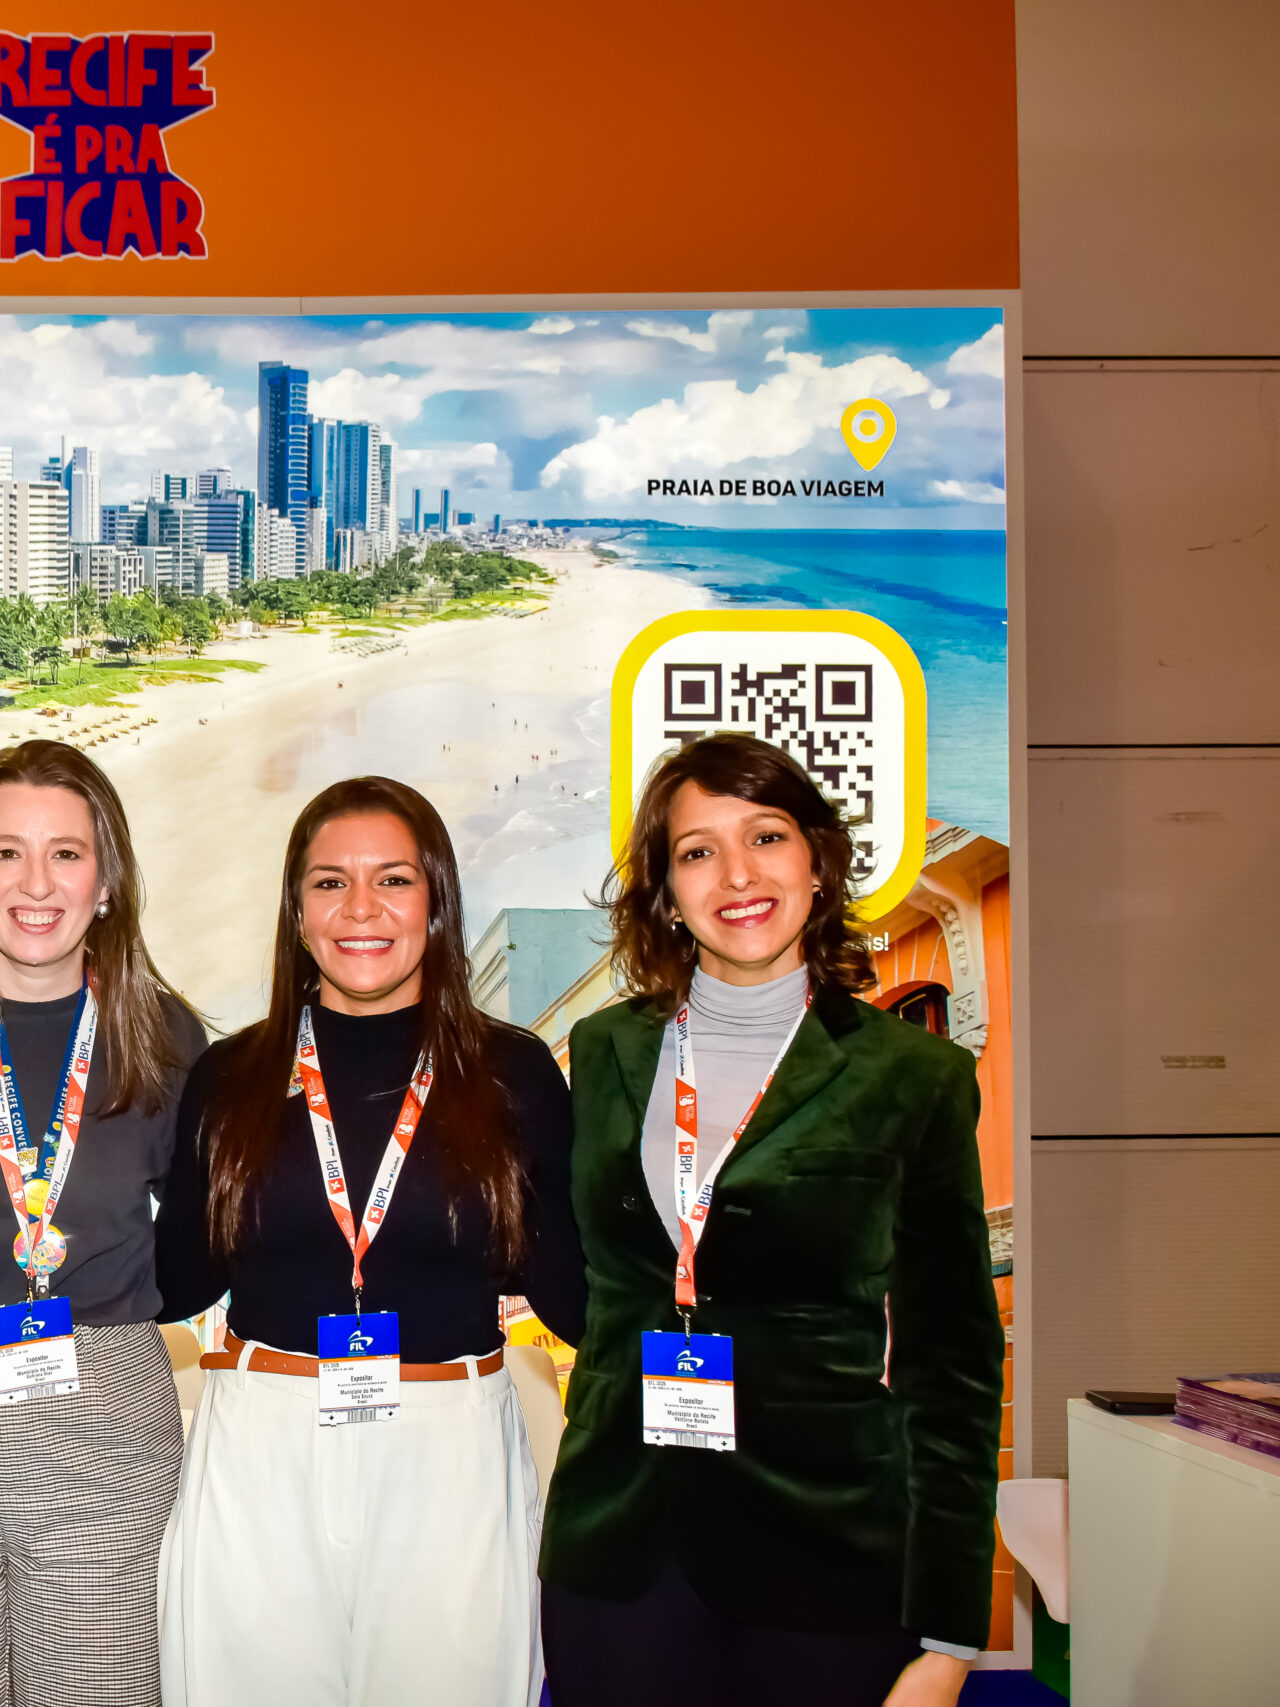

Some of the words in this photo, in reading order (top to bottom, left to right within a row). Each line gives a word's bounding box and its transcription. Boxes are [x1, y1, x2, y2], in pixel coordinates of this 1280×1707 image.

[33, 113, 62, 174] É
[75, 123, 169, 174] PRA
[0, 180, 207, 259] FICAR
[647, 479, 715, 496] PRAIA
[719, 480, 747, 496] DE
[752, 480, 797, 497] BOA
[800, 480, 885, 497] VIAGEM
[677, 1022, 688, 1041] BPI
[79, 1041, 90, 1060] BPI
[4, 1075, 18, 1110] RECIFE
[326, 1160, 340, 1179] BPI
[680, 1155, 692, 1173] BPI
[50, 1181, 62, 1201] BPI
[373, 1187, 389, 1209] BPI
[698, 1184, 713, 1206] BPI
[22, 1327, 37, 1336] FIL
[349, 1342, 365, 1351] FIL
[26, 1355, 49, 1363] Expositor
[677, 1362, 694, 1371] FIL
[678, 1397, 704, 1405] Expositor
